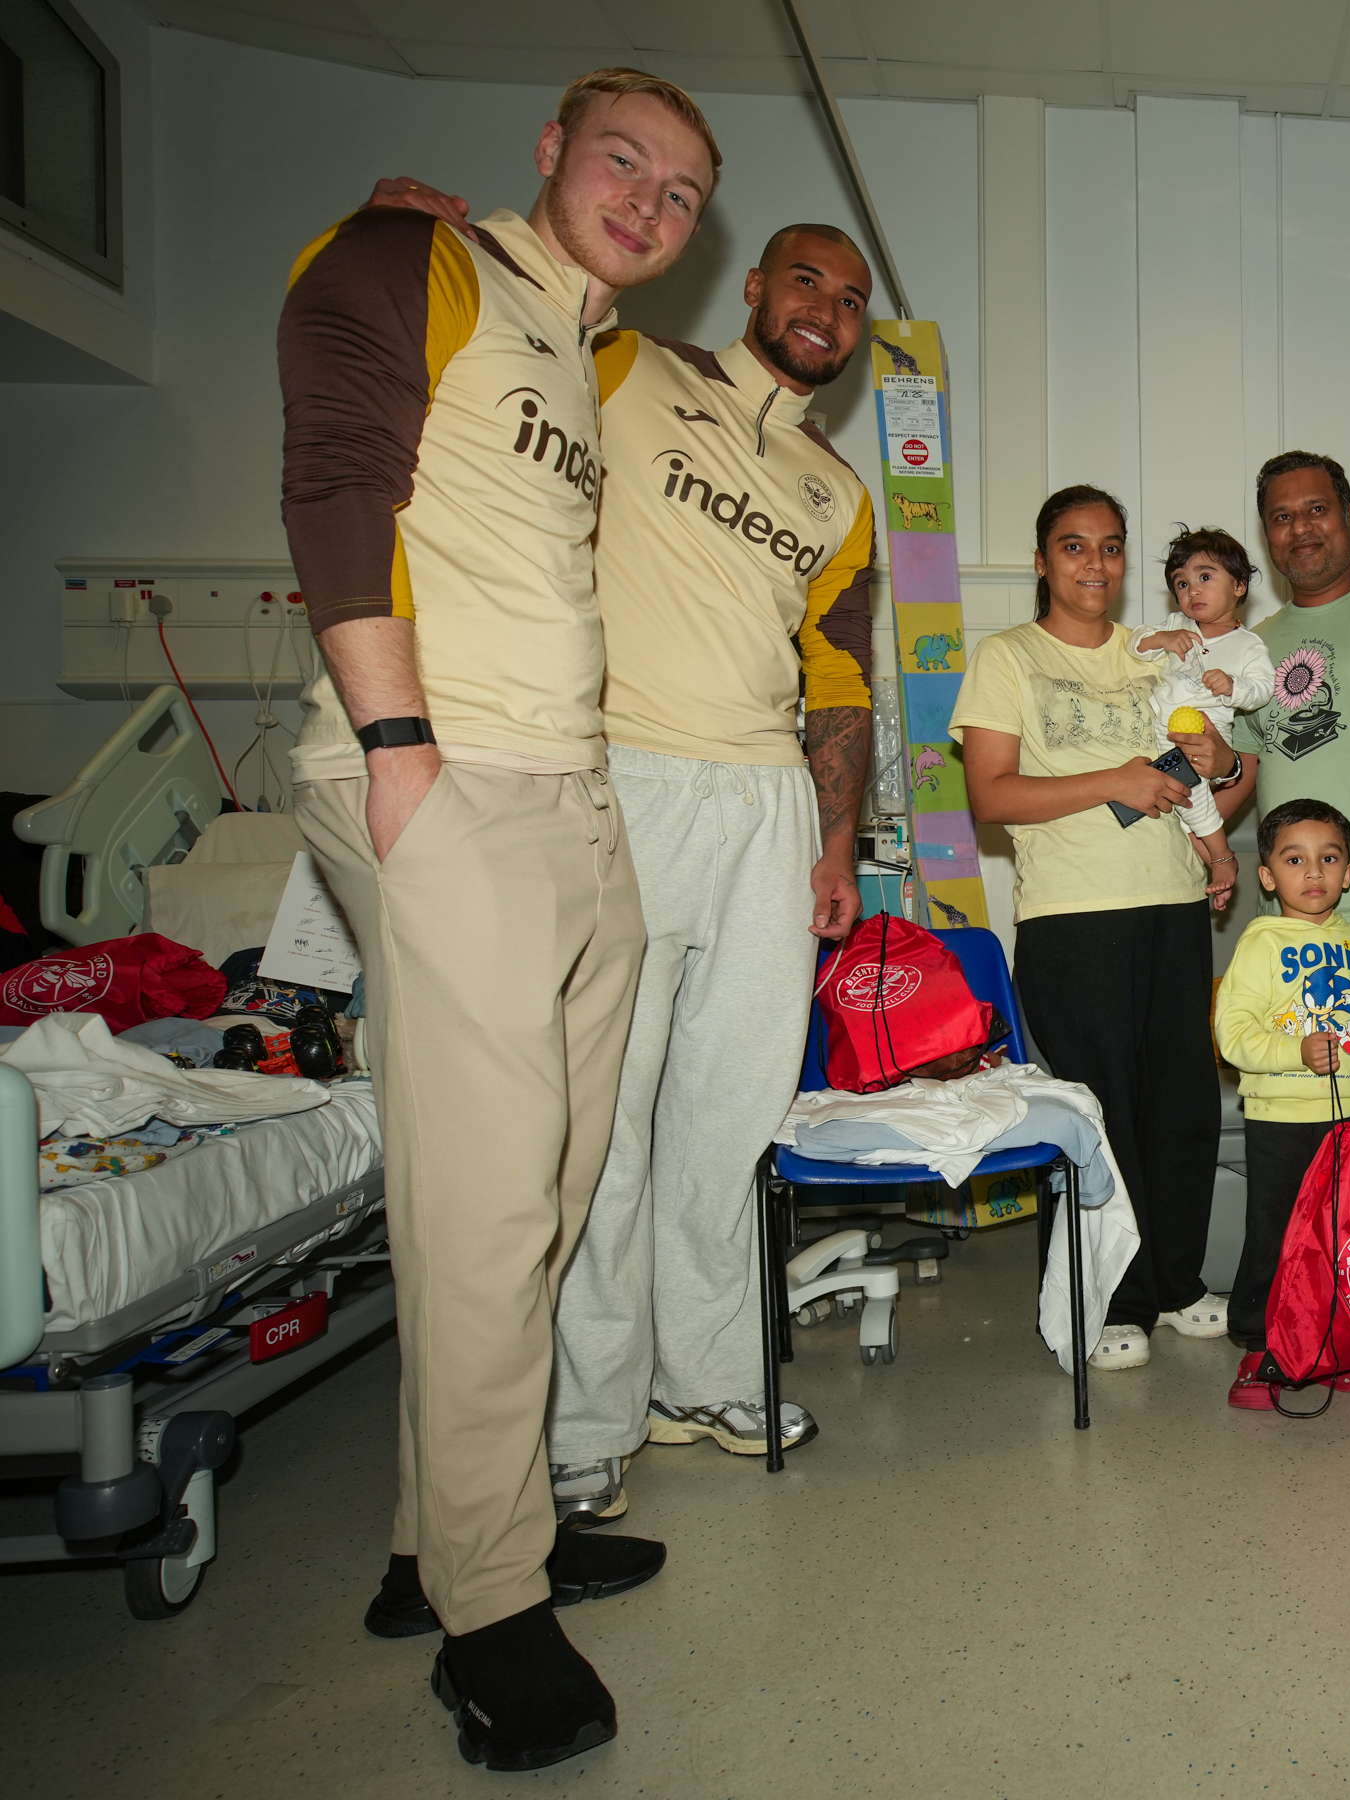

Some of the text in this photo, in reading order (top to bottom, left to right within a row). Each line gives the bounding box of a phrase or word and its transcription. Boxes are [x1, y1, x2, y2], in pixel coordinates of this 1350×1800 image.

[883, 376, 935, 385] BEHRENS
[495, 387, 601, 501] inde
[651, 449, 826, 577] indeed
[1265, 709, 1280, 754] MUSIC
[7, 978, 36, 1011] FOOTBALL
[900, 982, 916, 997] CLUB
[265, 1318, 300, 1345] CPR
